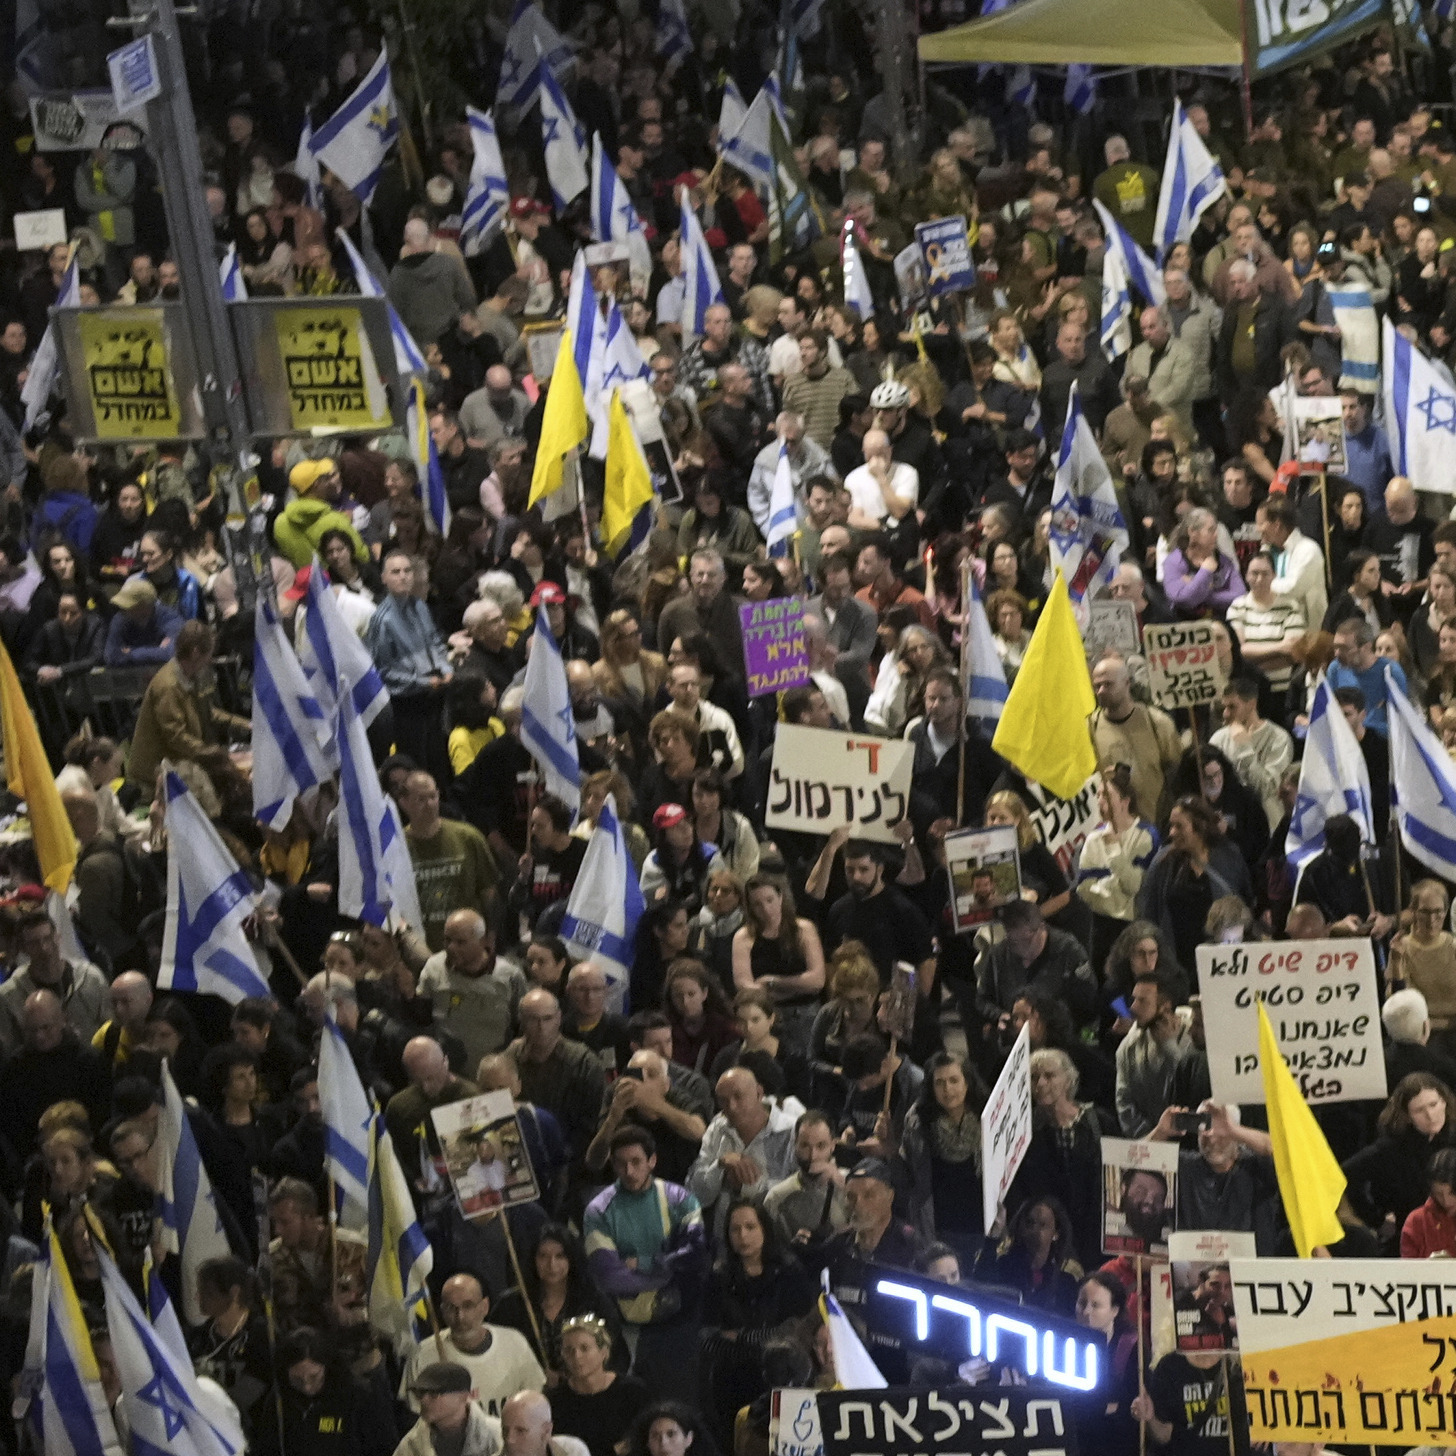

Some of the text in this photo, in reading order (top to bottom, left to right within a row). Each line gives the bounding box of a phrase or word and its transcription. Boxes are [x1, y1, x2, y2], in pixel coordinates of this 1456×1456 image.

[92, 368, 165, 398] אשם
[290, 360, 361, 388] אשם
[96, 400, 172, 421] במחדל
[292, 393, 365, 412] במחדל
[1147, 626, 1211, 649] כולם!
[1149, 645, 1215, 672] עכשיו!
[1165, 668, 1213, 690] בכל
[846, 740, 882, 774] די
[770, 768, 905, 828] לנירמול
[1210, 948, 1358, 978] דיפ שיט ולא
[1316, 984, 1361, 1006] דיפ
[1280, 1015, 1369, 1042] שאנחנו
[1236, 1055, 1259, 1075] בו
[1234, 1280, 1314, 1318] עבר
[877, 1281, 1097, 1392] שחרר
[1246, 1387, 1345, 1430] המתה
